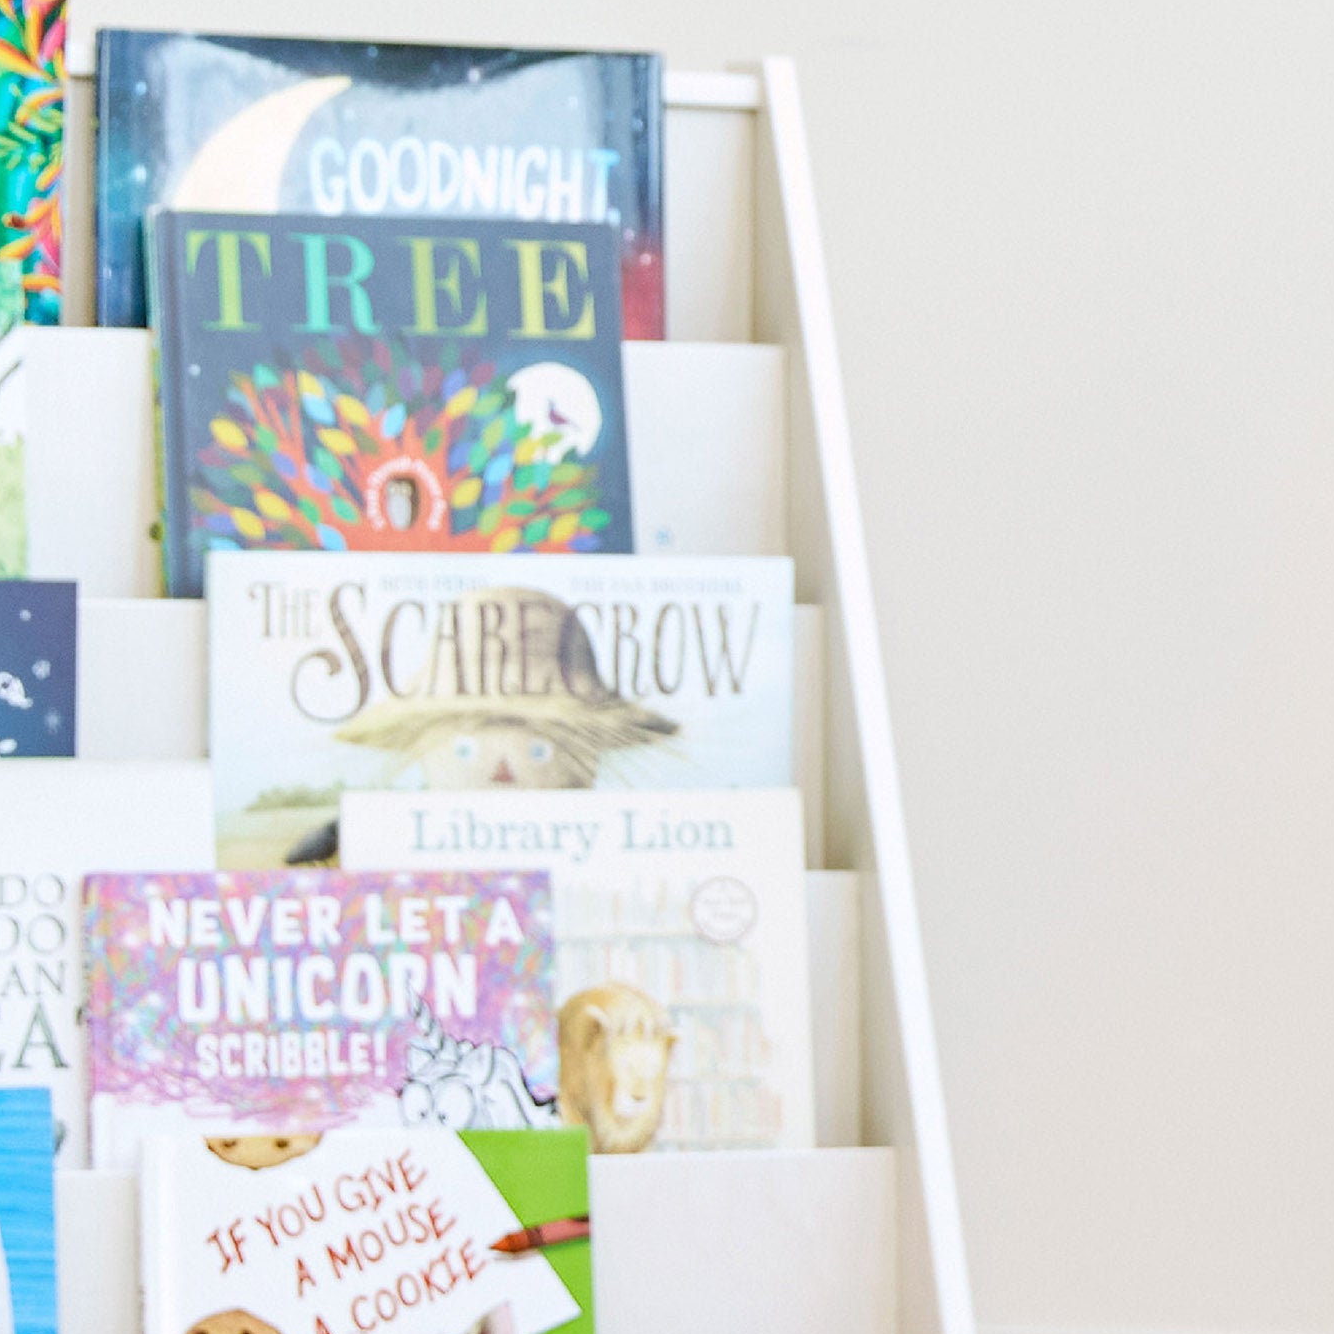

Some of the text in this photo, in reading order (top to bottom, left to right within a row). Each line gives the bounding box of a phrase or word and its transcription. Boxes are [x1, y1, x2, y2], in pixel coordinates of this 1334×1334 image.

[185, 227, 597, 341] TREE
[247, 579, 761, 723] THE SCARECROW
[410, 808, 736, 862] Library Lion
[148, 893, 524, 948] NEVER LET A
[0, 962, 66, 998] AN
[177, 953, 479, 1024] UNICORN
[194, 1030, 388, 1080] SCRIBBLE!
[206, 1148, 429, 1274] IF YOU GIVE
[294, 1198, 458, 1299] A MOUSE
[350, 1236, 487, 1334] COOKIE
